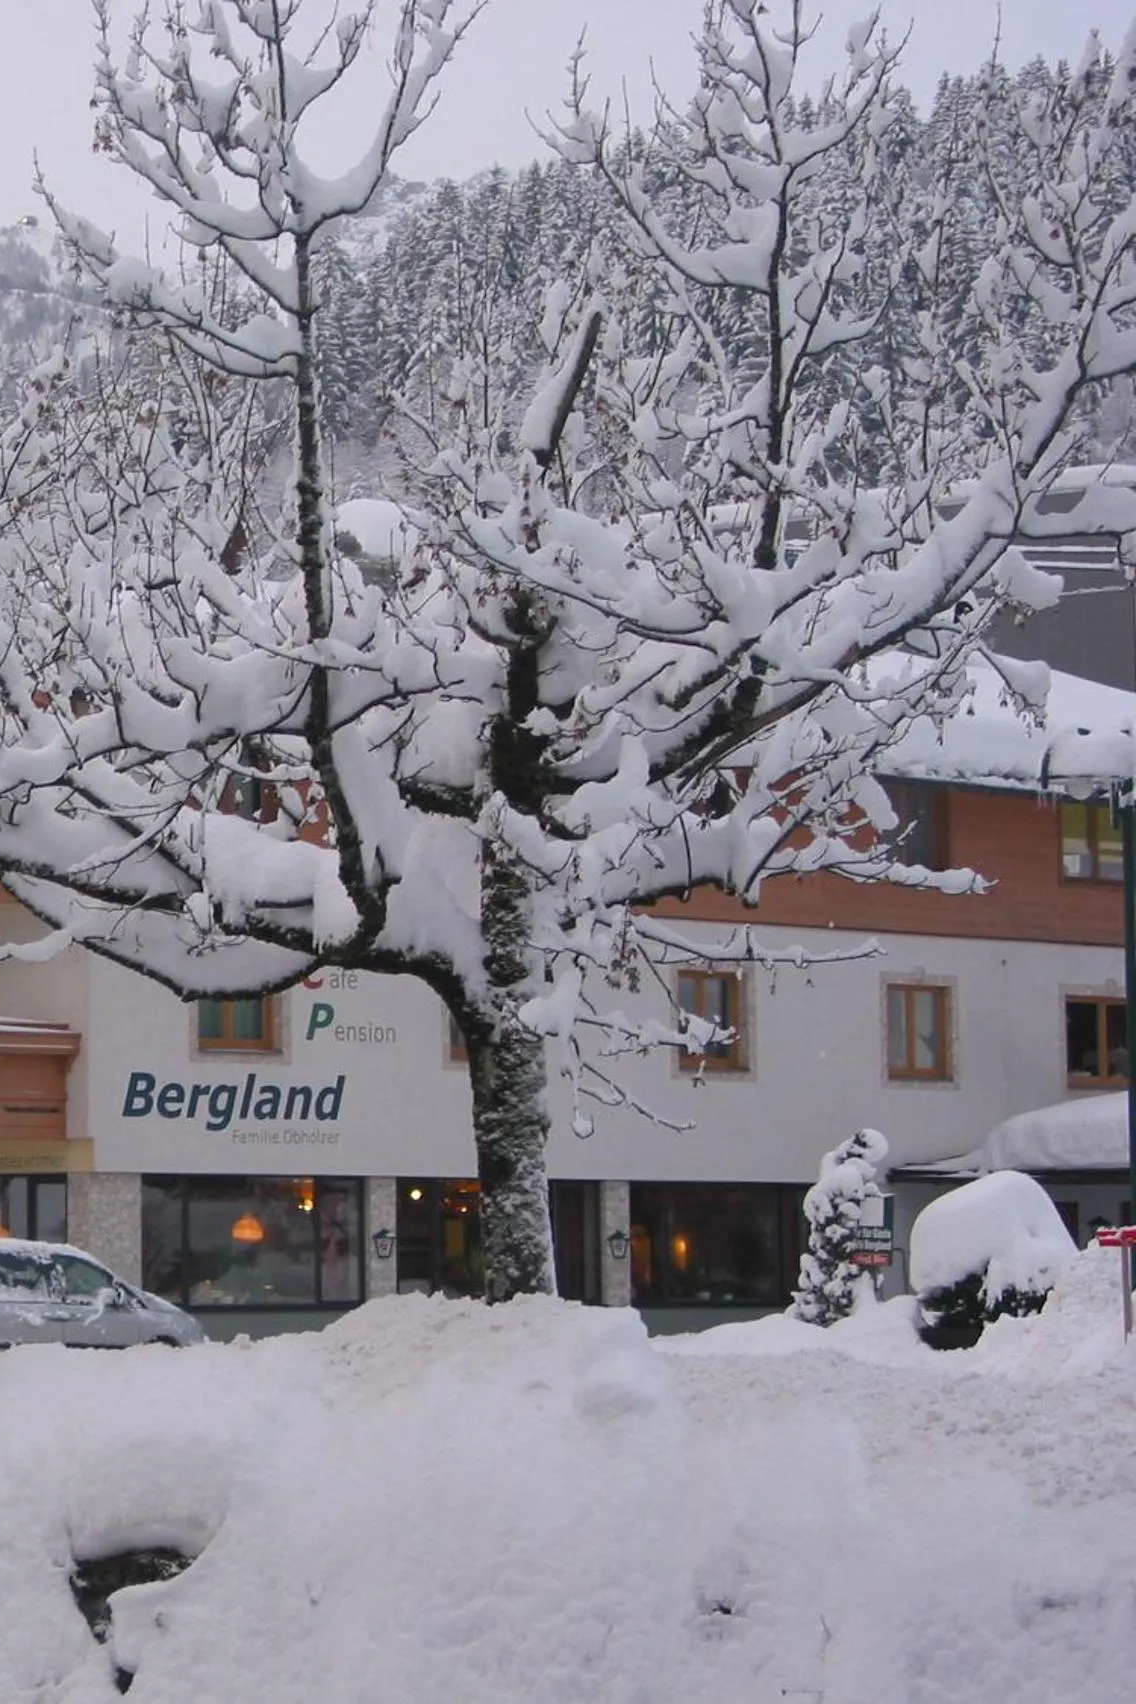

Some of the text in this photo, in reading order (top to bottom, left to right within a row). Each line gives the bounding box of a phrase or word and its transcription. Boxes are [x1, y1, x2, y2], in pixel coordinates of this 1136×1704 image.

[306, 1002, 396, 1042] Pension
[122, 1071, 346, 1132] Bergland
[232, 1128, 281, 1144] Familie
